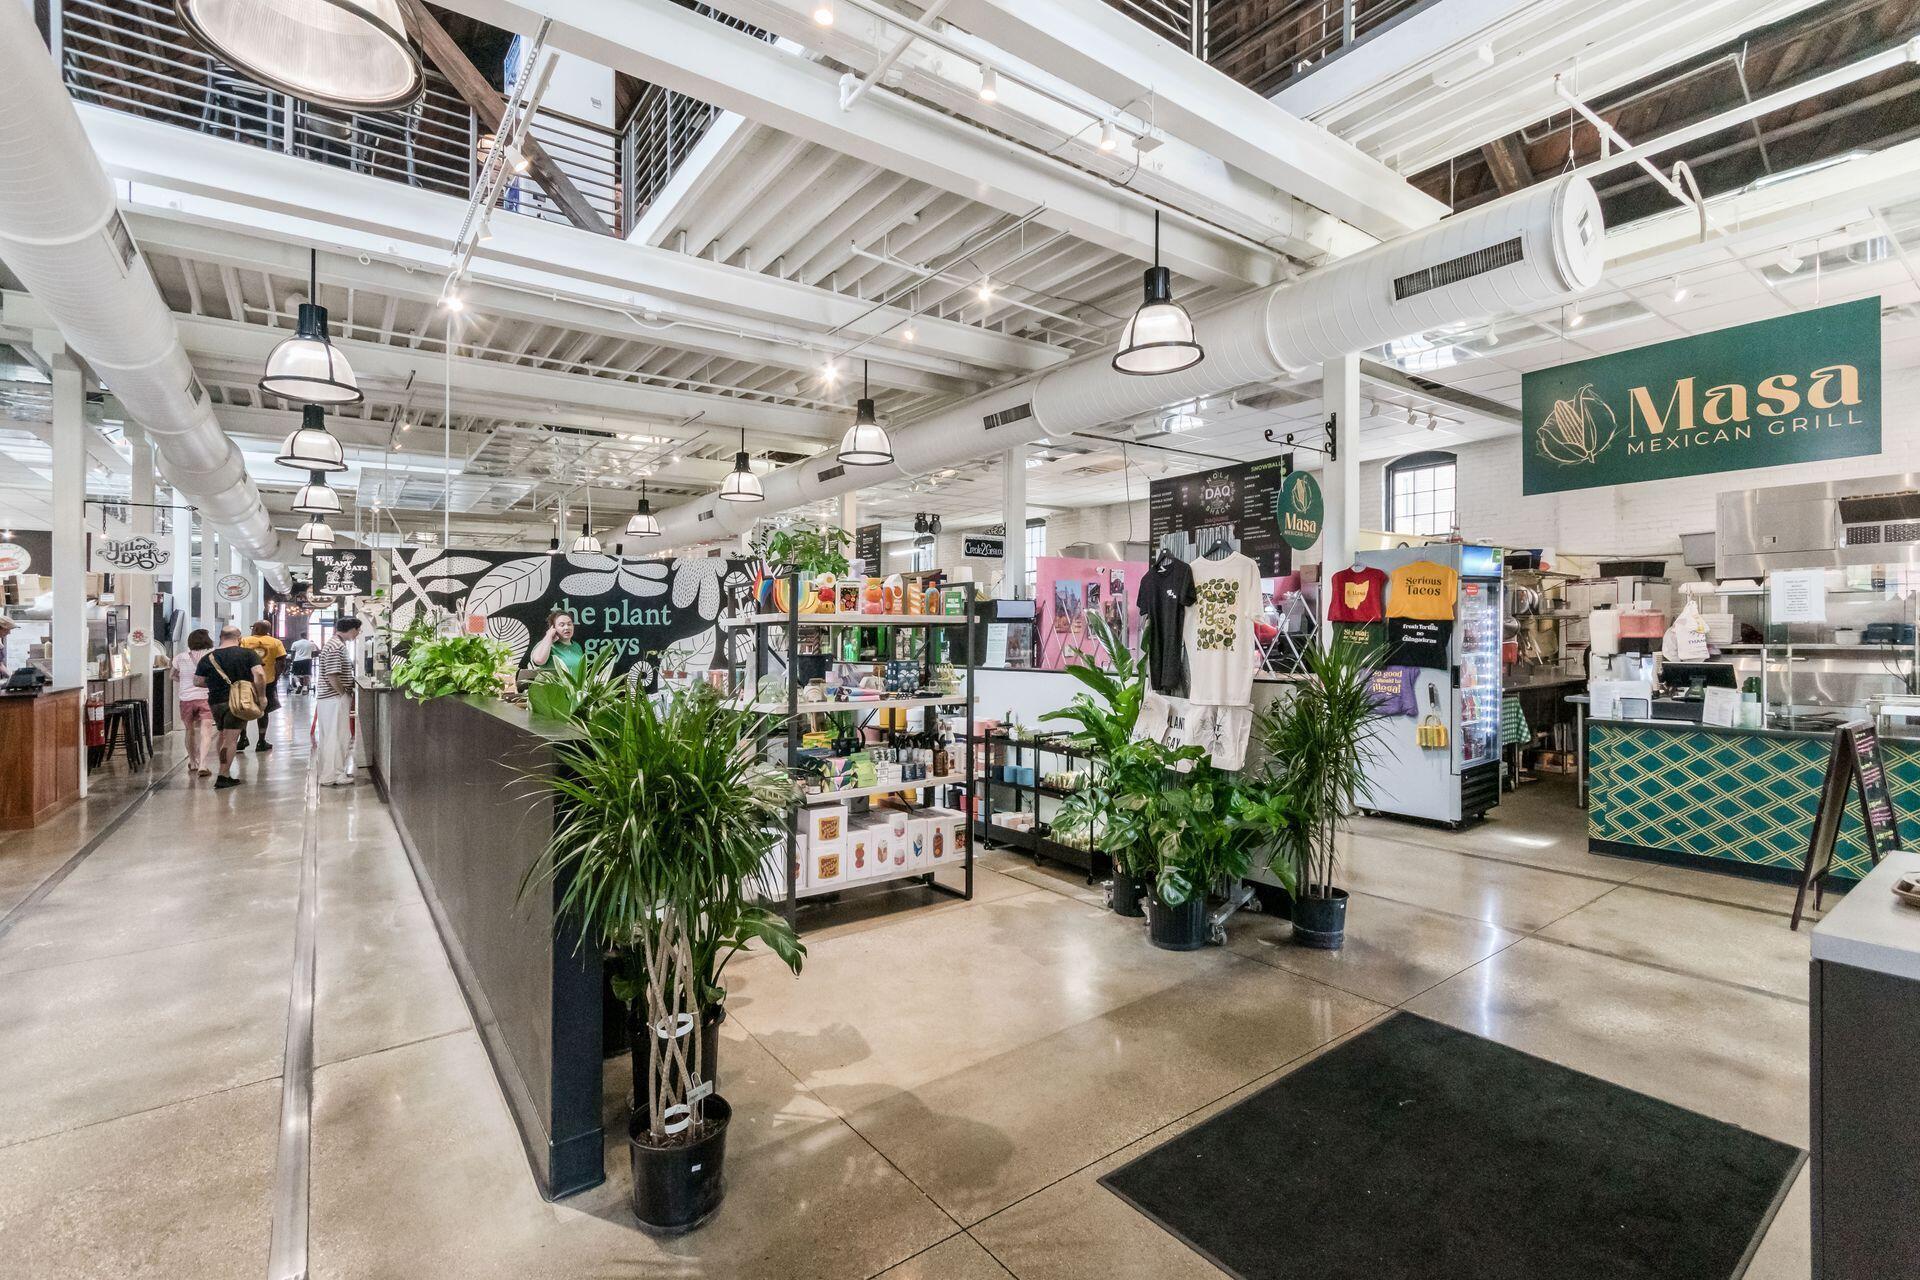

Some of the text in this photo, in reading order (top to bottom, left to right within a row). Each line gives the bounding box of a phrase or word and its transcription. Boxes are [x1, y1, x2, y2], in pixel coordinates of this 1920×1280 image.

[1627, 363, 1863, 438] Masa
[1627, 410, 1863, 455] MEXICAN GRILL
[1206, 471, 1230, 484] NOLA
[1205, 485, 1231, 500] DAQ
[1205, 502, 1231, 515] SHACK
[1285, 511, 1317, 533] Masa
[1405, 576, 1442, 586] Serious
[1407, 585, 1441, 596] Tacos
[604, 599, 672, 633] plant
[1383, 670, 1403, 679] good
